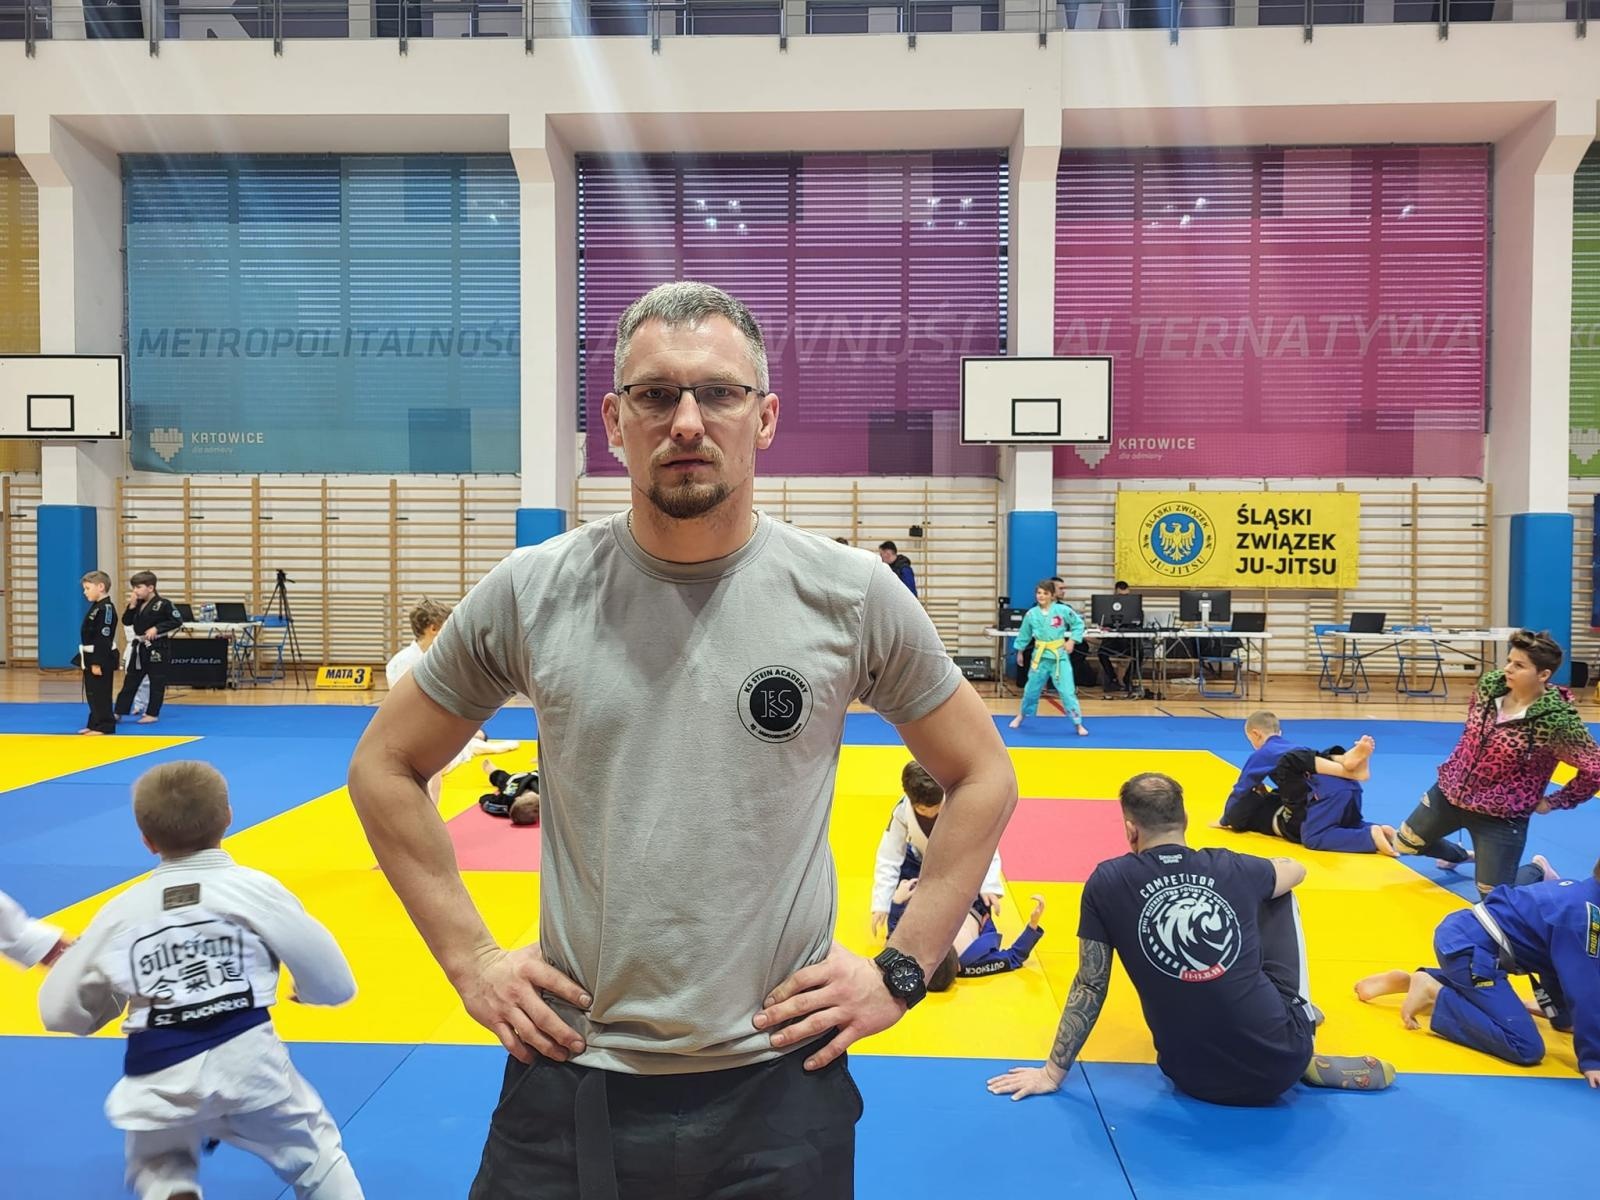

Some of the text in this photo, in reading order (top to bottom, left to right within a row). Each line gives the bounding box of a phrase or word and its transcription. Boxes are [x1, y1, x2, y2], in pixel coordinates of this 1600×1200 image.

[1056, 314, 1480, 360] ALTERNATYWA
[191, 431, 265, 444] KATOWICE
[1118, 437, 1196, 450] KATOWICE
[1145, 504, 1209, 529] ŚLĄSKI ZWIĄZEK
[1236, 503, 1312, 530] ŚLĄSKI
[1235, 533, 1337, 555] ZWIĄZEK
[1150, 557, 1206, 575] JU-JITSU
[1235, 557, 1337, 575] JU-JITSU
[325, 668, 365, 684] MATA 3
[743, 669, 809, 694] KS STEIN ACADEMY
[1140, 873, 1215, 899] COMPETITOR
